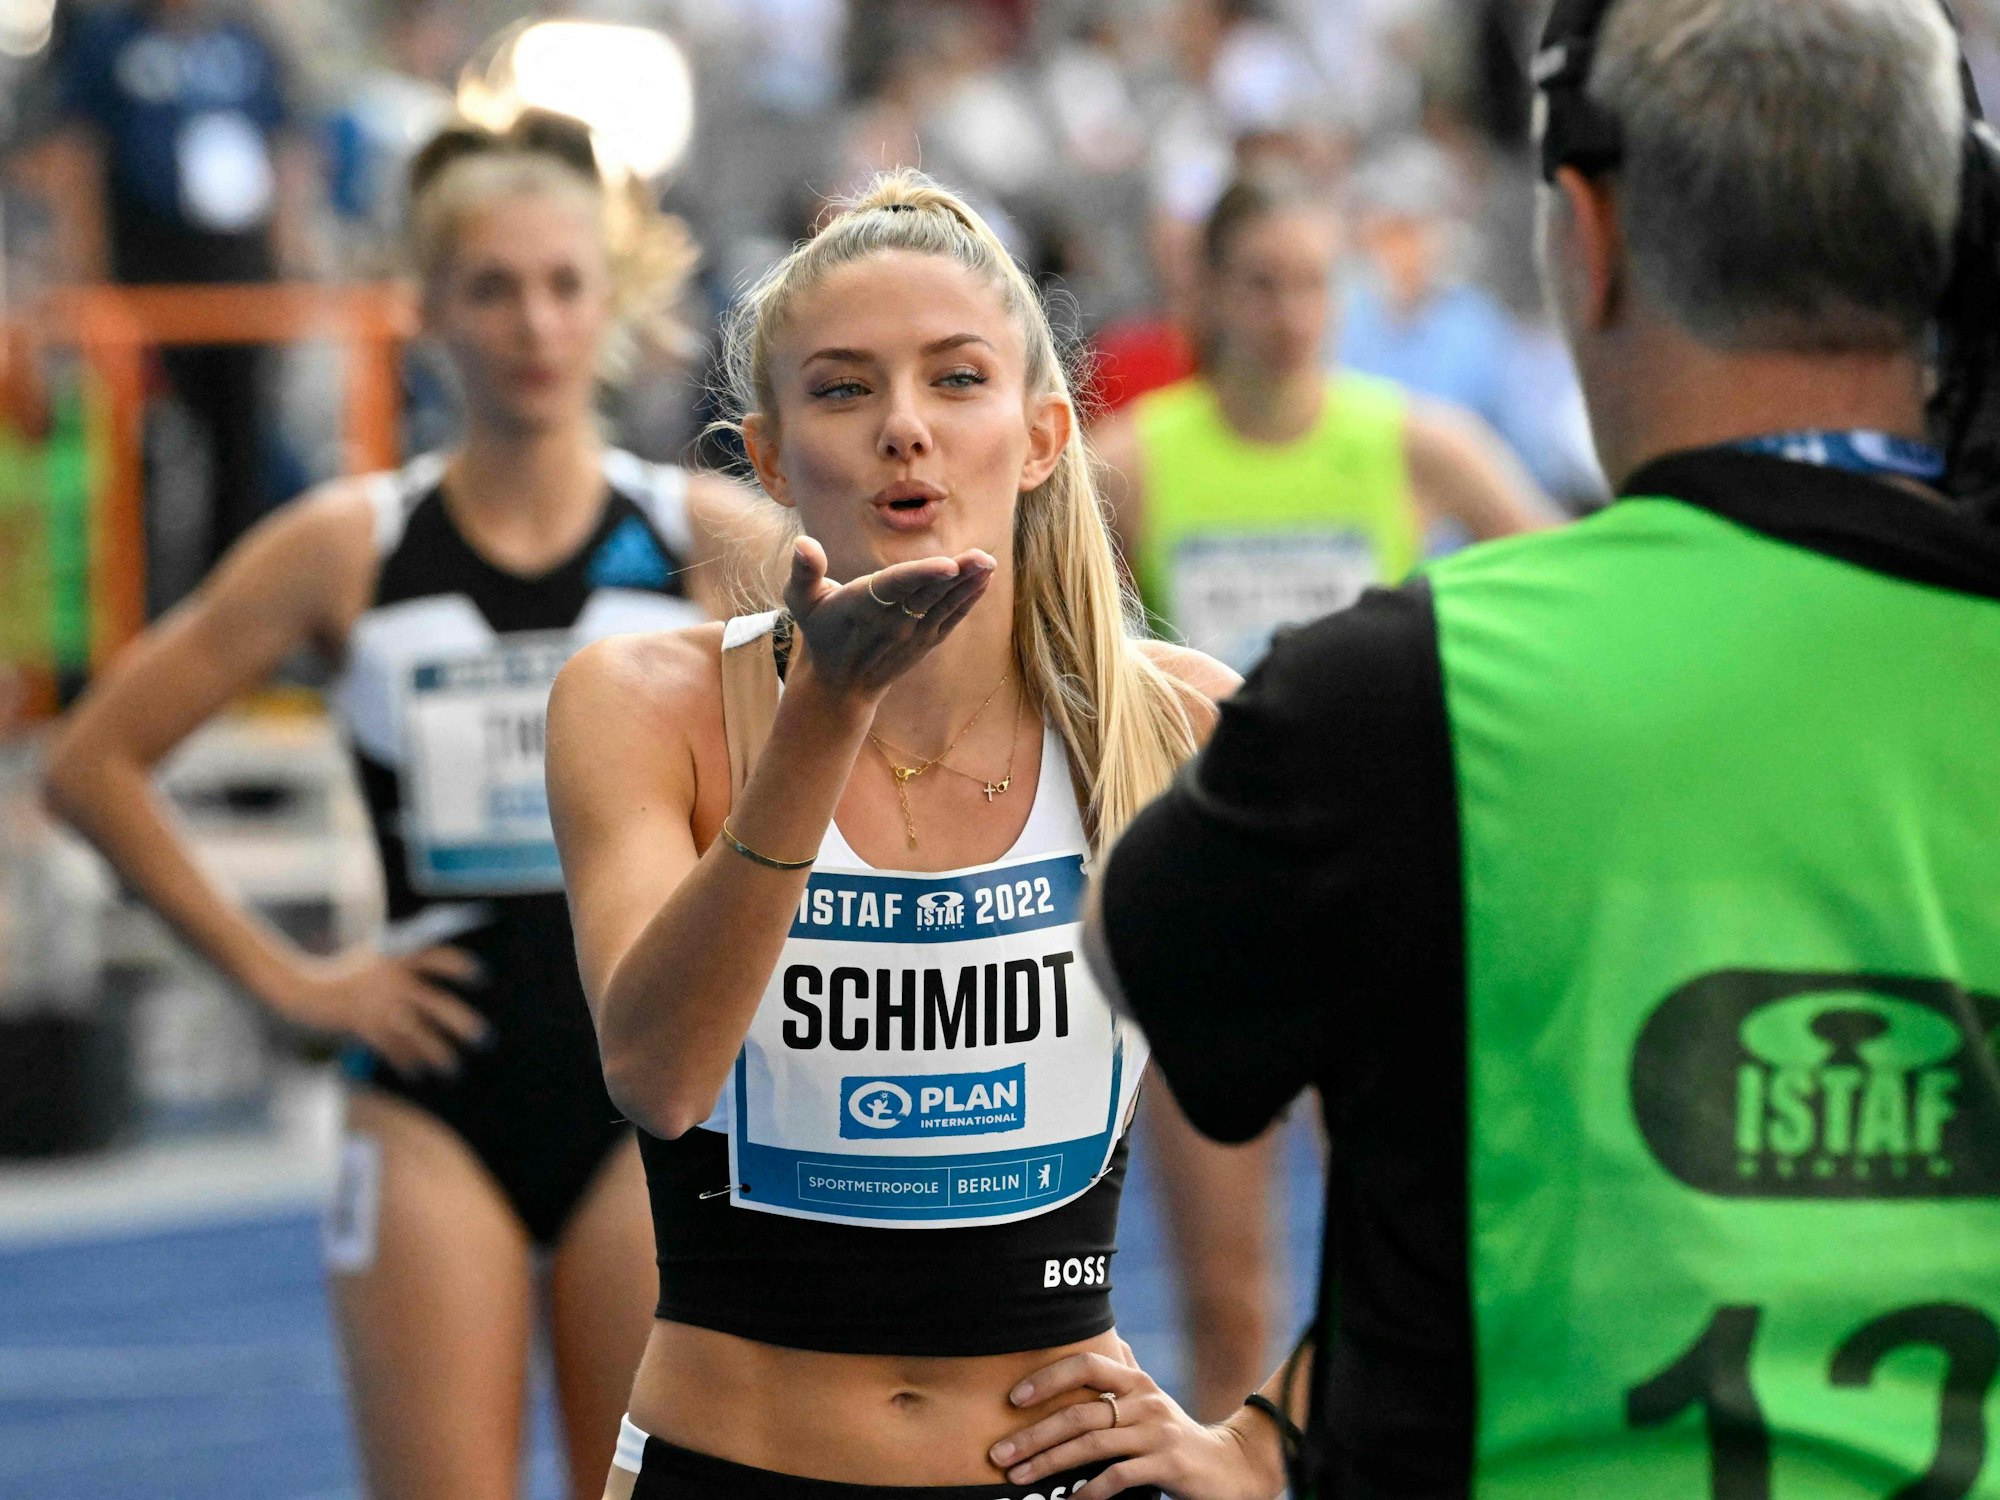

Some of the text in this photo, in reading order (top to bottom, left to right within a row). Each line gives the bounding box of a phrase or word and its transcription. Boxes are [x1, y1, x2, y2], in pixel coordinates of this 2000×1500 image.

[799, 877, 1055, 928] ISTAF 2022
[916, 905, 965, 926] ISTAF
[782, 950, 1075, 1051] SCHMIDT
[920, 1080, 1018, 1114] PLAN
[1735, 1063, 1960, 1157] ISTAF
[920, 1113, 1018, 1128] INTERNATIONAL
[808, 1174, 1020, 1194] SPORTMETROPOLE BERLIN
[1043, 1255, 1106, 1288] BOSS
